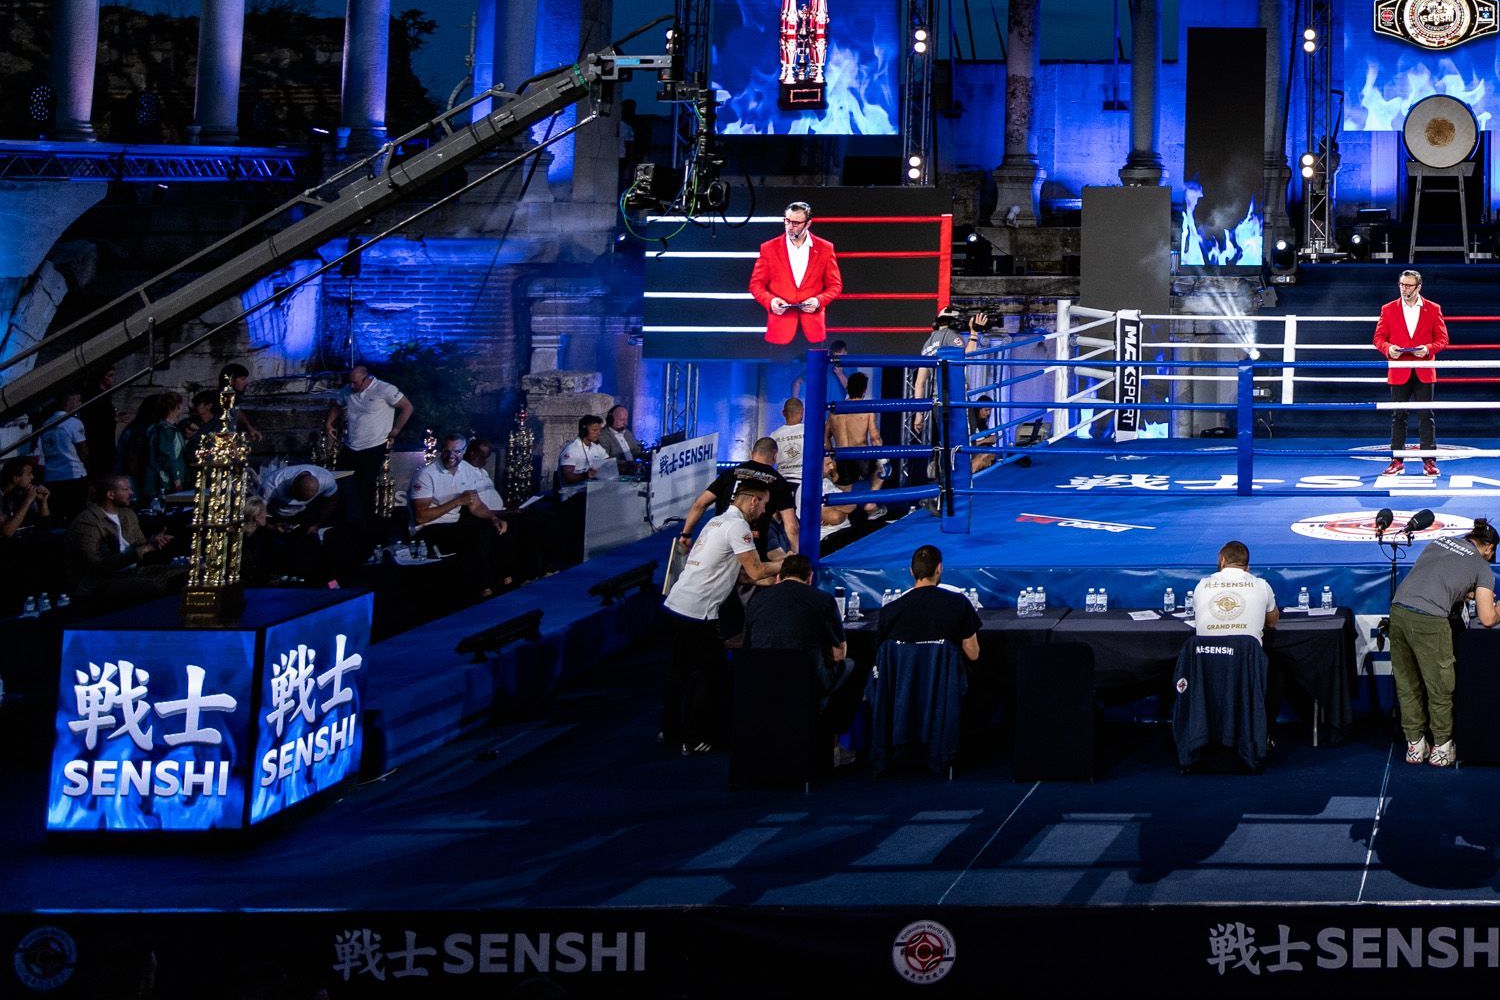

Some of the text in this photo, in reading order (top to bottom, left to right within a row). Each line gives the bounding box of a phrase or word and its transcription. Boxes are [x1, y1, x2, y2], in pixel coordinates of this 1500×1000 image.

[658, 443, 714, 477] 戦士 SENSHI
[1445, 538, 1474, 556] SENSHI
[1204, 646, 1234, 656] SENSHI
[67, 659, 237, 751] 戦士
[266, 634, 362, 738] 戦士
[62, 759, 229, 797] SENSHI
[261, 713, 356, 788] SENSHI
[333, 927, 646, 983] 戦士 SENSHI
[1206, 921, 1311, 977] 戦士
